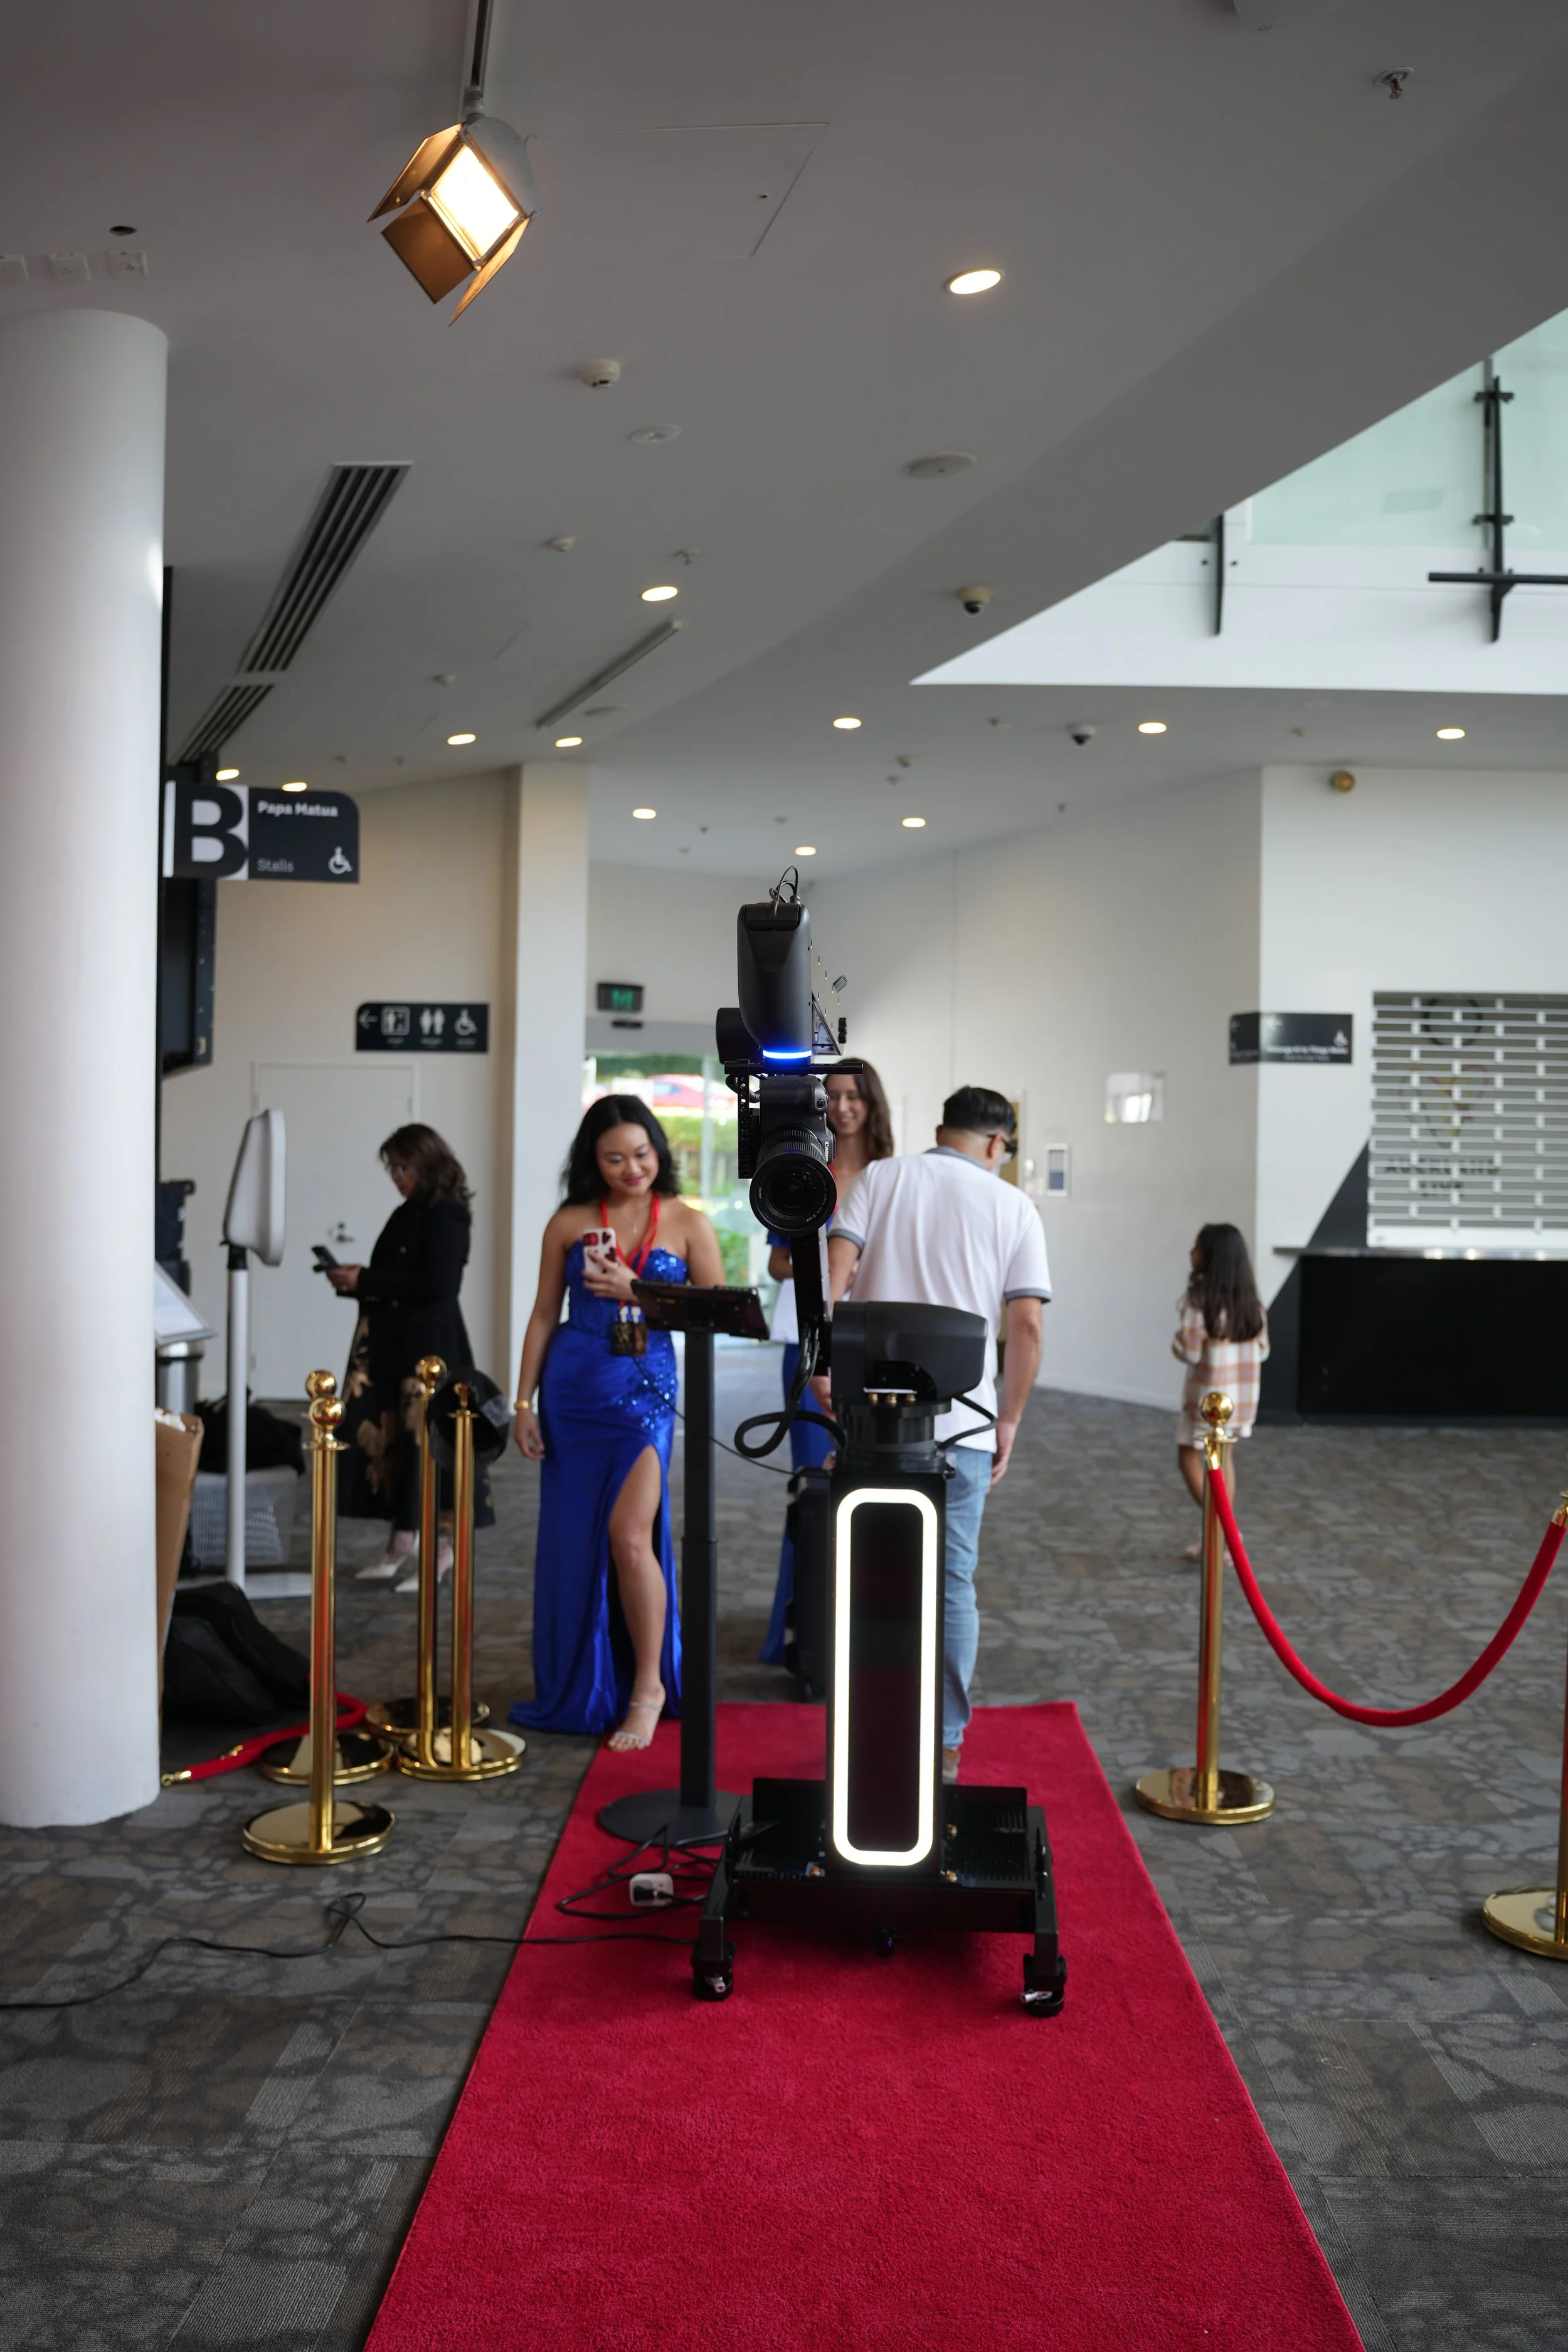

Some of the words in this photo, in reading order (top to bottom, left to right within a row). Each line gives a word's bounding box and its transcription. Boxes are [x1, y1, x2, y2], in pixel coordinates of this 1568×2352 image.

[258, 800, 294, 817] Papa
[295, 803, 339, 818] Matua
[175, 784, 249, 879] B
[257, 857, 295, 873] Stalls
